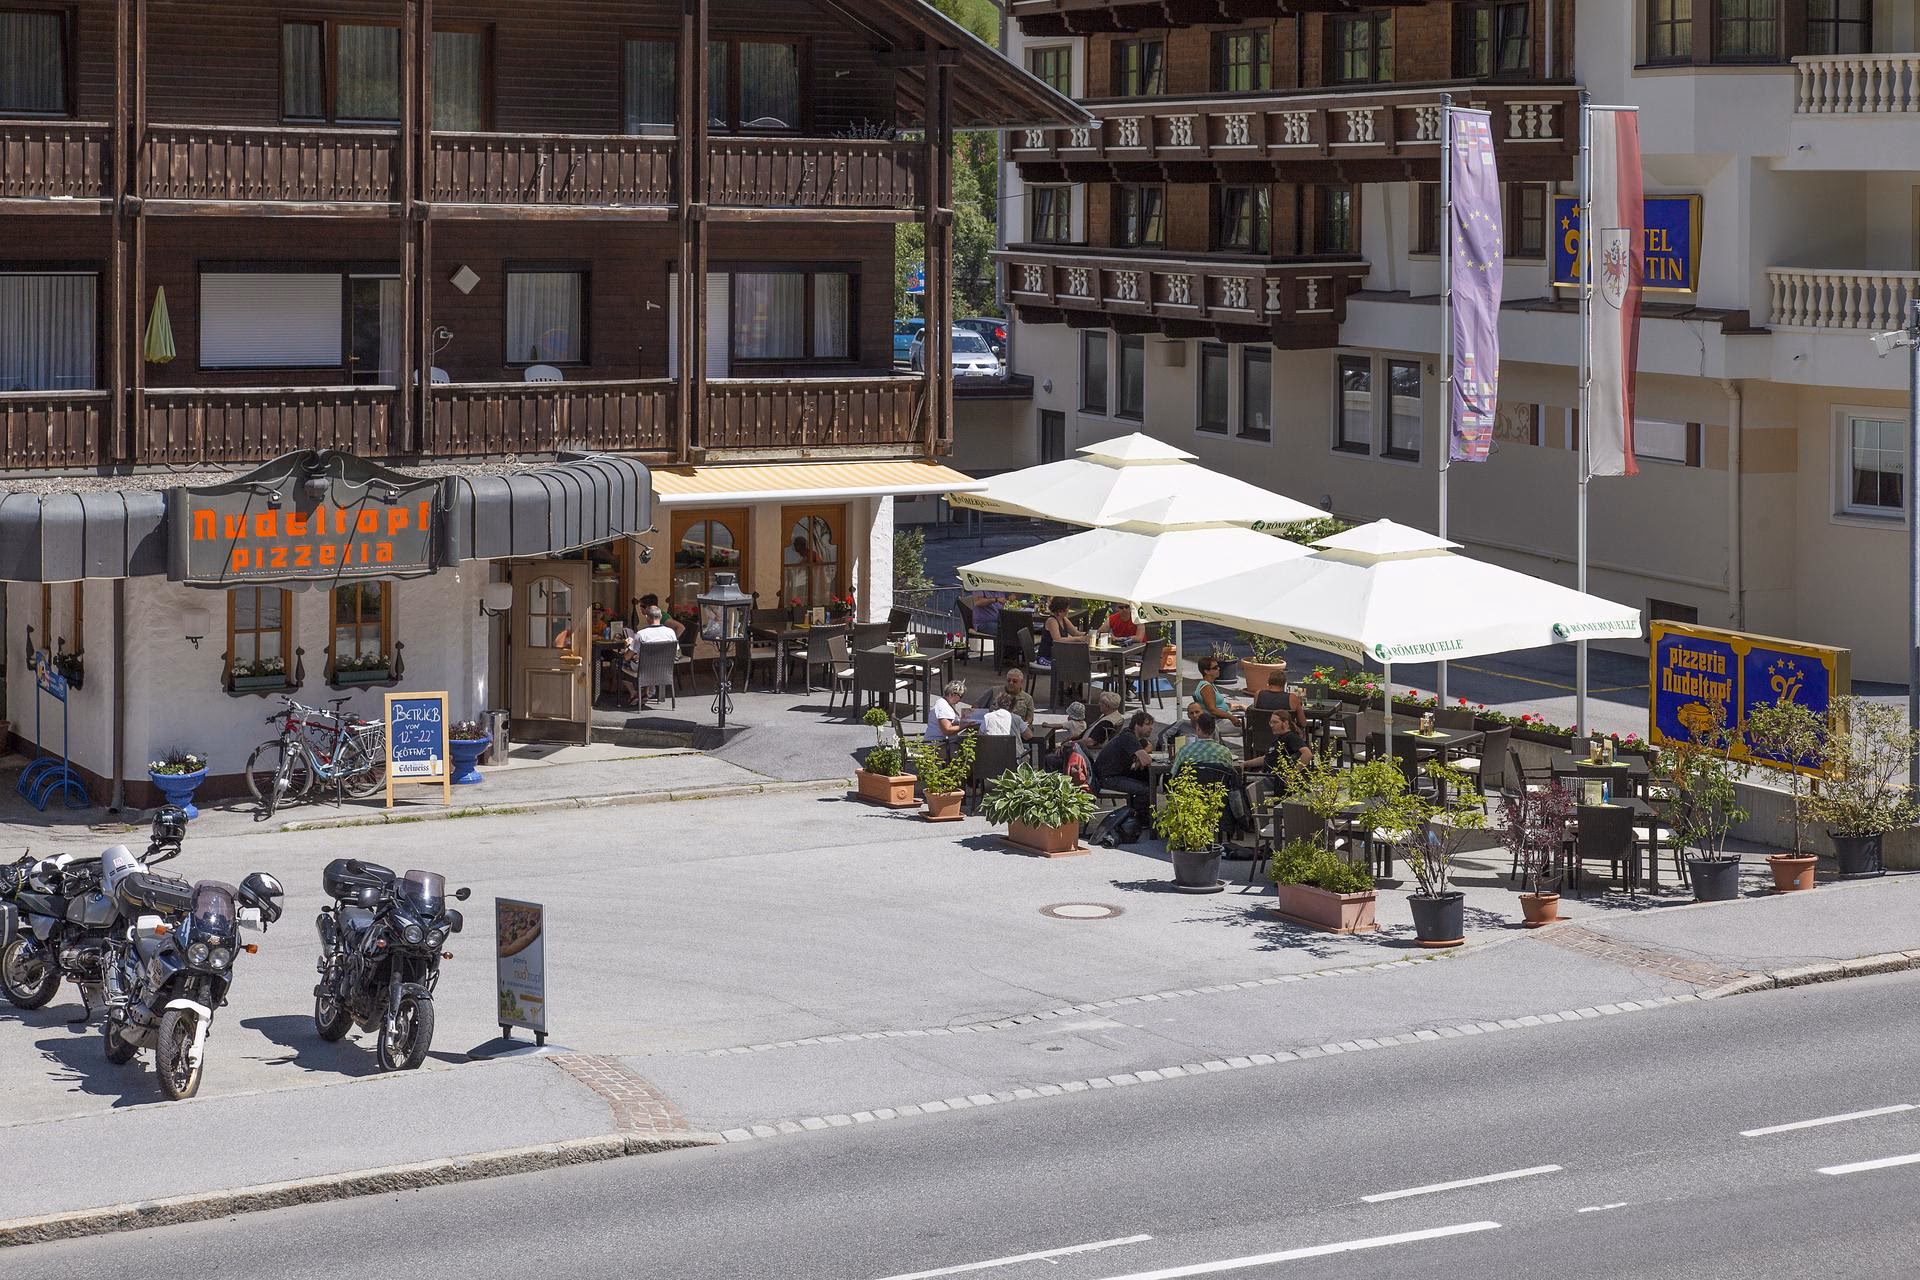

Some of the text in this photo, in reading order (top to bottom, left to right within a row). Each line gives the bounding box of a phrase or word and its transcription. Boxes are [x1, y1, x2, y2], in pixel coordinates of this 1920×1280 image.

[231, 541, 393, 573] pizzeria
[1569, 619, 1637, 633] RÖMERQUELLE
[1391, 639, 1464, 657] RÖMERQUELLE
[1668, 644, 1727, 675] pizzeria
[1661, 667, 1733, 703] Nudeltopf
[398, 763, 430, 774] Edelweiss
